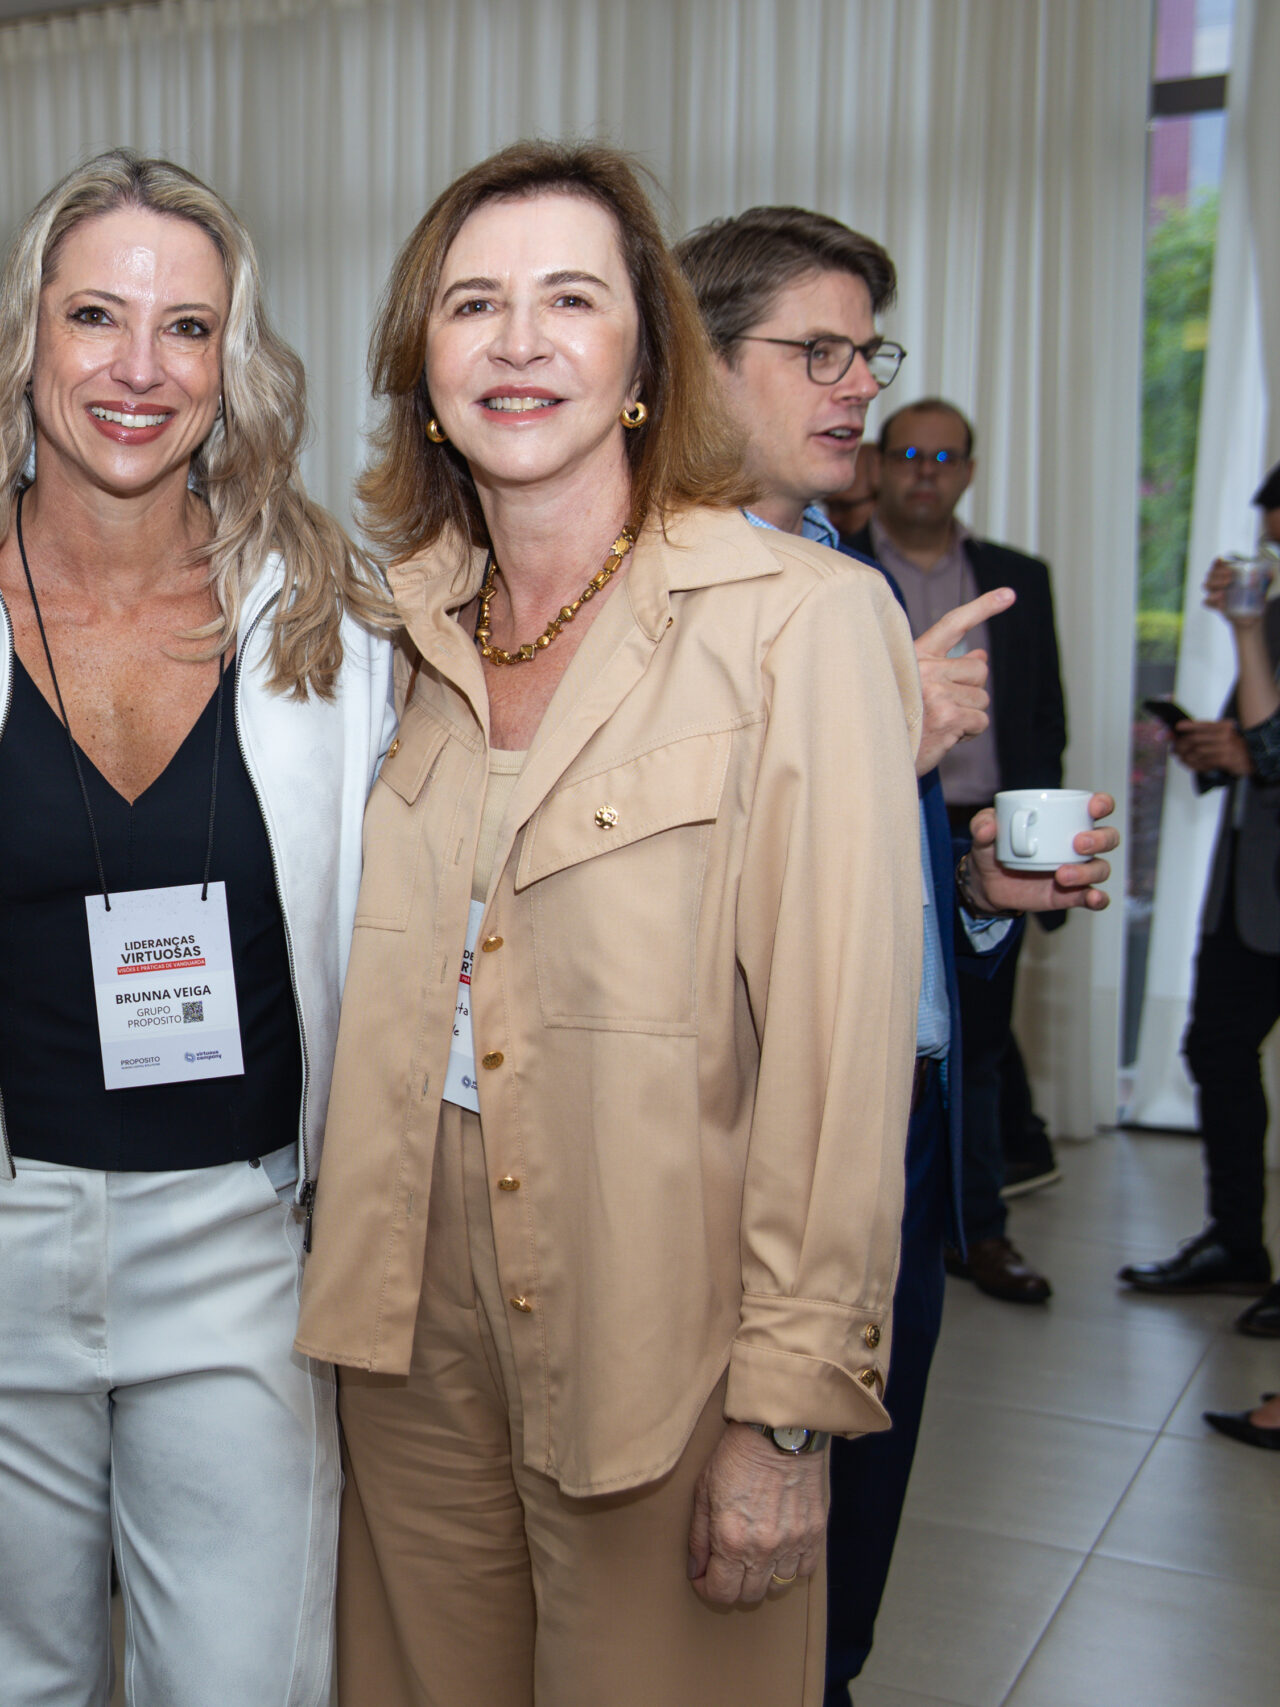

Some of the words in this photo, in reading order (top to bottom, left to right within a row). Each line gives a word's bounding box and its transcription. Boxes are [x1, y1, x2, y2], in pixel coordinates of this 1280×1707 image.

[125, 935, 195, 951] LIDERANÇAS
[121, 945, 201, 964] VIRTUOSAS
[115, 989, 171, 1005] BRUNNA
[173, 985, 211, 998] VEIGA
[136, 1005, 171, 1017] GRUPO
[127, 1015, 182, 1028] PROPOSITO
[120, 1056, 161, 1066] PROPOSITO
